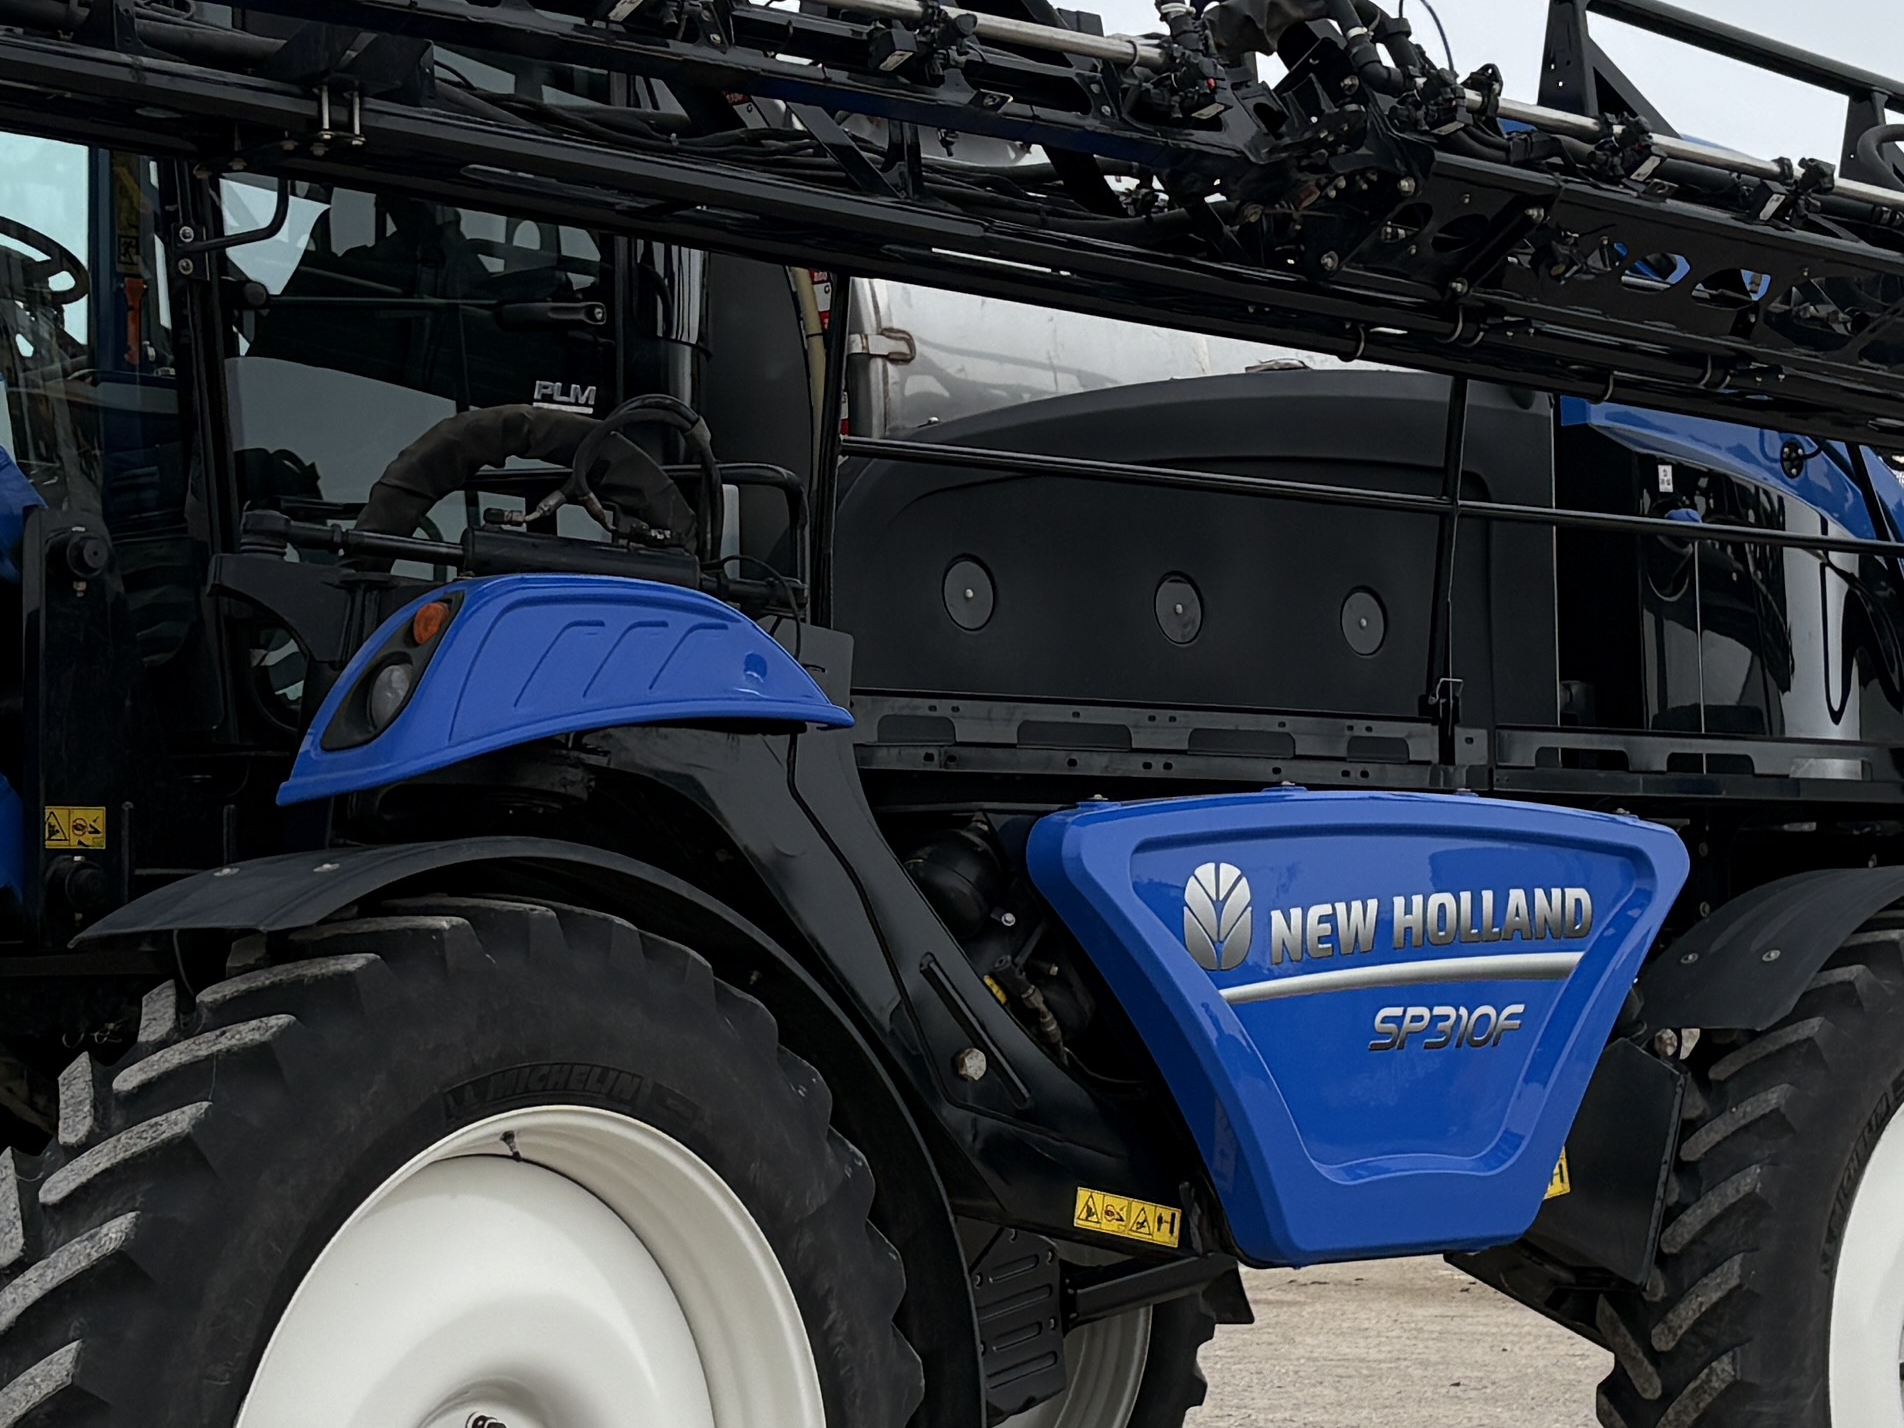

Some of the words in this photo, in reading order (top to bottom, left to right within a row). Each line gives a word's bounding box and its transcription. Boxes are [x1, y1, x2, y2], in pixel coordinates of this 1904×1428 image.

[534, 380, 597, 405] PLM
[1270, 898, 1378, 965] NEW
[1392, 887, 1593, 950] HOLLAND
[1368, 1003, 1526, 1051] SP310F
[487, 1063, 643, 1103] MICHELIN
